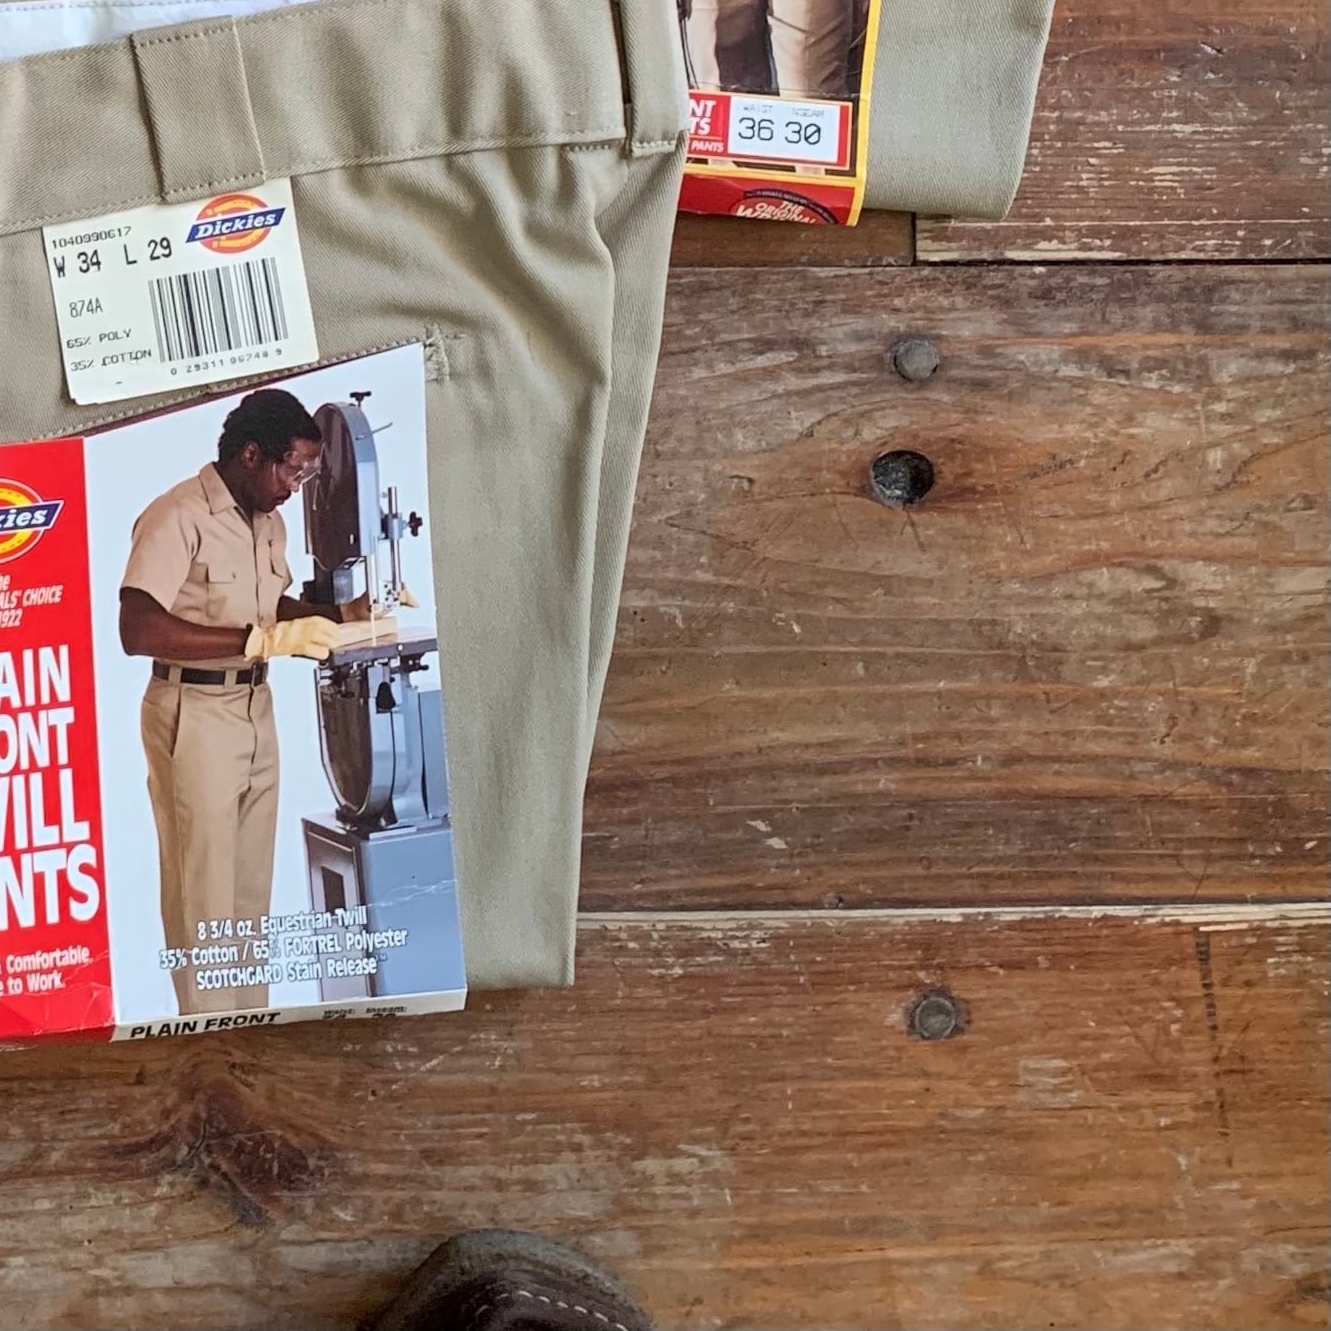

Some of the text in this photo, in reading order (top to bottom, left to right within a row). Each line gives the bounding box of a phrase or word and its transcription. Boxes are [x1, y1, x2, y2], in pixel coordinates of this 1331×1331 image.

[738, 116, 774, 142] 36
[784, 120, 822, 146] 30
[691, 140, 724, 153] PANTS
[778, 200, 805, 214] THE
[52, 226, 132, 250] 1040990617
[194, 212, 276, 240] Dickies
[53, 236, 172, 278] W 34 L 29
[69, 297, 104, 318] 874A
[66, 328, 132, 350] 65% POLY
[70, 348, 152, 373] 35% COTTON
[170, 367, 178, 376] 0
[186, 359, 225, 374] 29311
[22, 584, 64, 607] CHOICE
[197, 904, 368, 941] 8 3/4 oz. Equestrian Twill
[160, 948, 187, 970] 35%
[191, 944, 238, 966] Cotton
[252, 939, 282, 961] 65%
[284, 934, 342, 958] FORTREL
[346, 927, 408, 953] Polyester
[196, 954, 378, 990] SCOTCHGARD Stain Release
[6, 974, 24, 995] to
[130, 1011, 282, 1038] PLAIN FRONT
